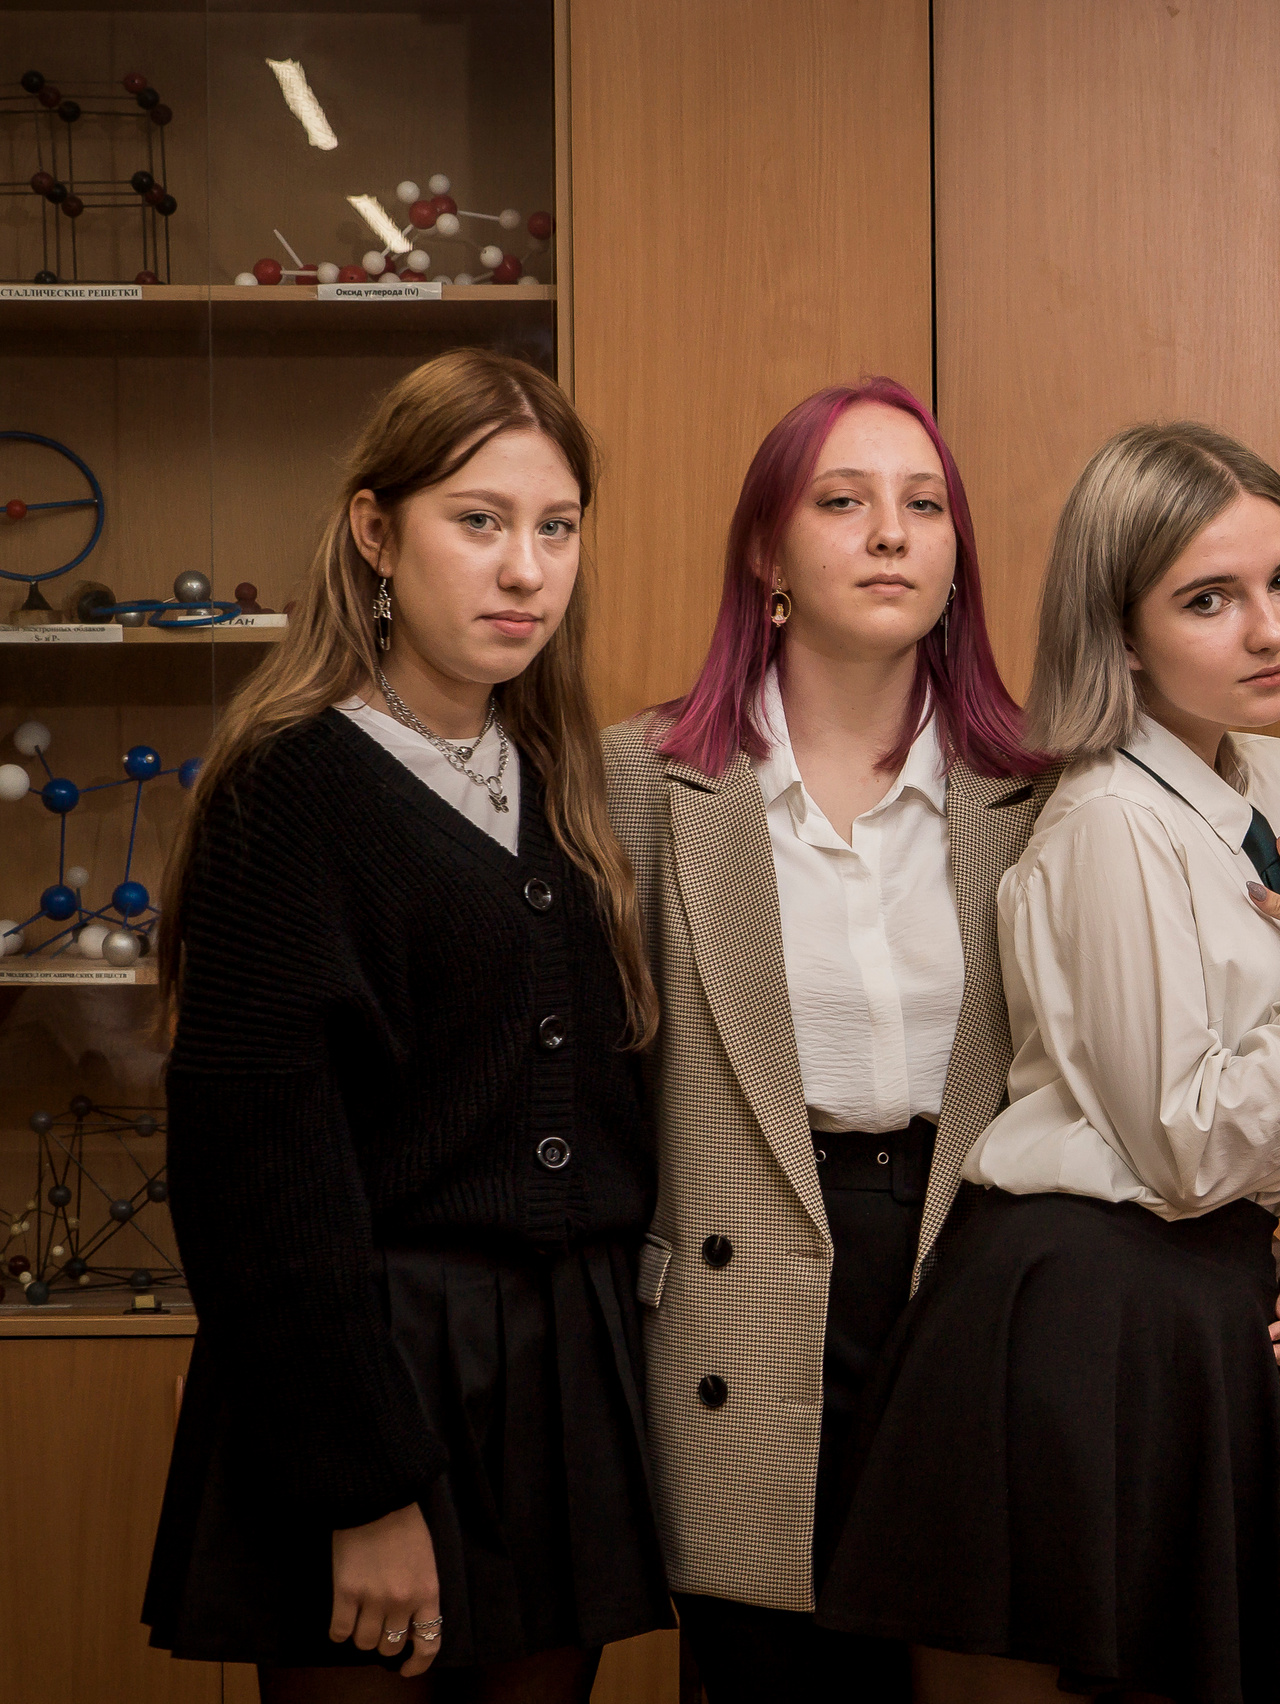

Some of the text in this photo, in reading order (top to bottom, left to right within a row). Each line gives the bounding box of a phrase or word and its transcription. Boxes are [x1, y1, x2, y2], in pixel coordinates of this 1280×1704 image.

[88, 288, 138, 297] РЕШЕТКИ
[335, 288, 419, 297] Оксид углерода (IV)
